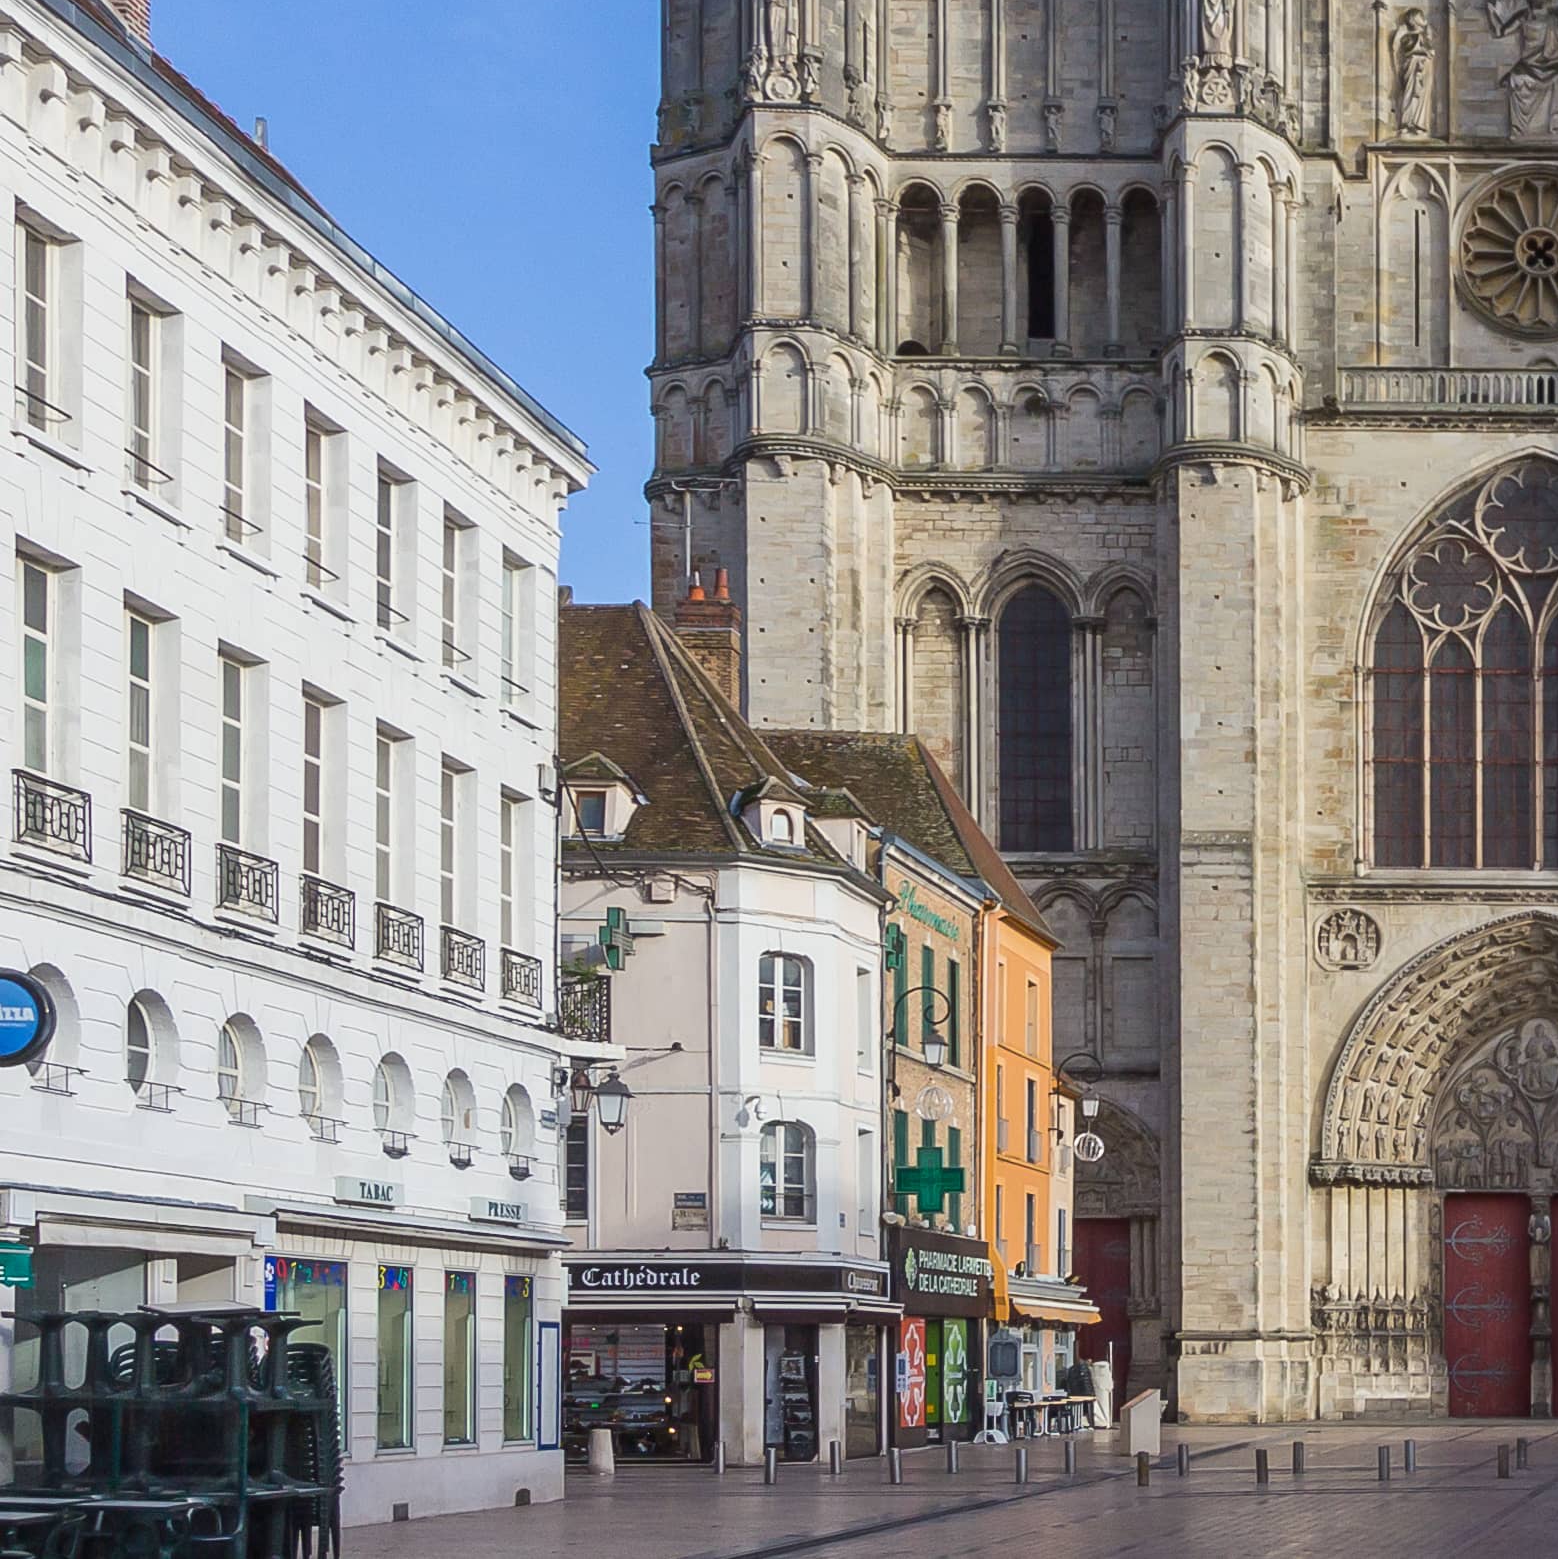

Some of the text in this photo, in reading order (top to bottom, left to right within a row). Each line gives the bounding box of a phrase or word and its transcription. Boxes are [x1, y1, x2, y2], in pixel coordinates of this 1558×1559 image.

[359, 1181, 394, 1202] TABAC
[487, 1201, 522, 1220] PRESSE
[918, 1249, 958, 1272] PHARMACIE
[581, 1265, 701, 1290] Cathédrale
[918, 1273, 928, 1292] DE
[928, 1275, 939, 1293] LA
